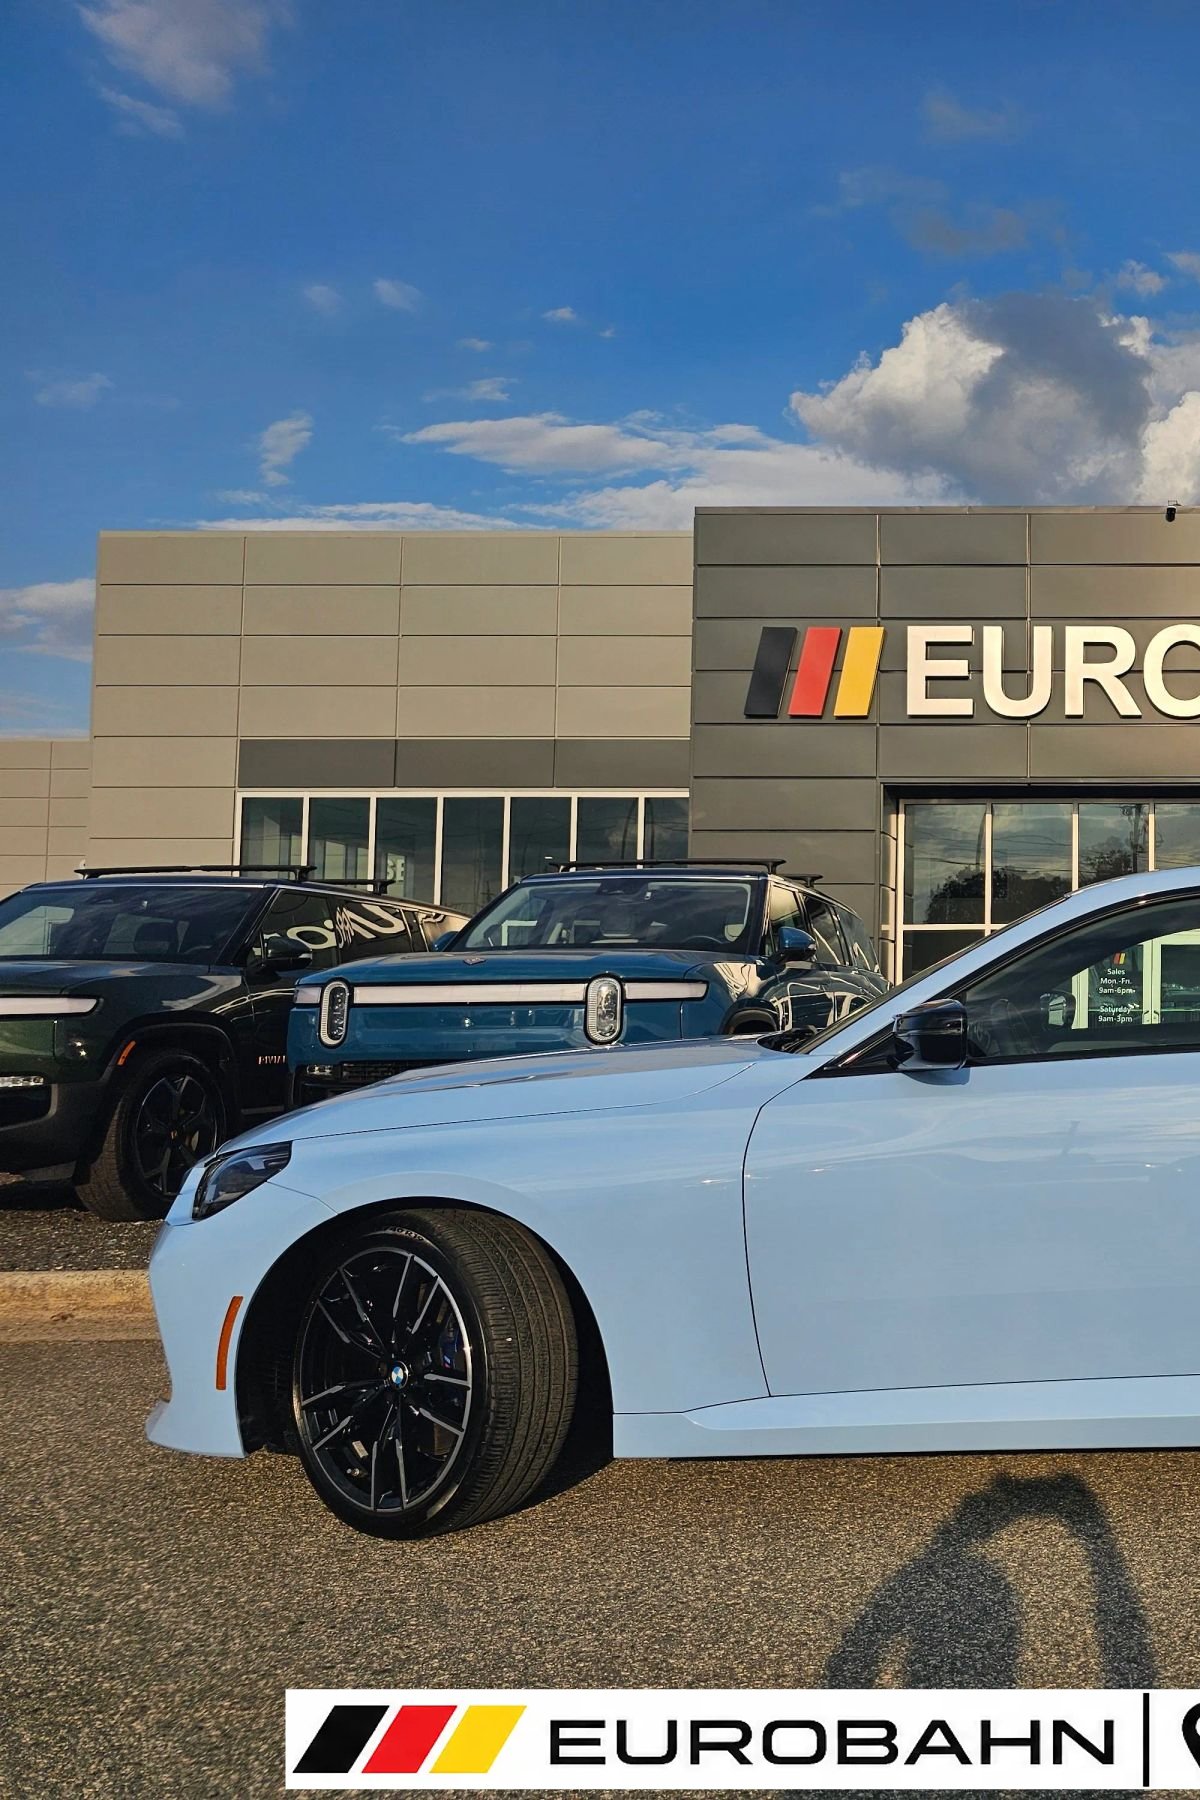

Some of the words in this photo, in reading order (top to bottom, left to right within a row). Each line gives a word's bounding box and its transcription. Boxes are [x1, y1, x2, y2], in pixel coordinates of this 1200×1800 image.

[1098, 986, 1133, 995] 9am-6pm
[1099, 1005, 1131, 1015] Saturday
[1098, 1014, 1133, 1024] 9am-3pm
